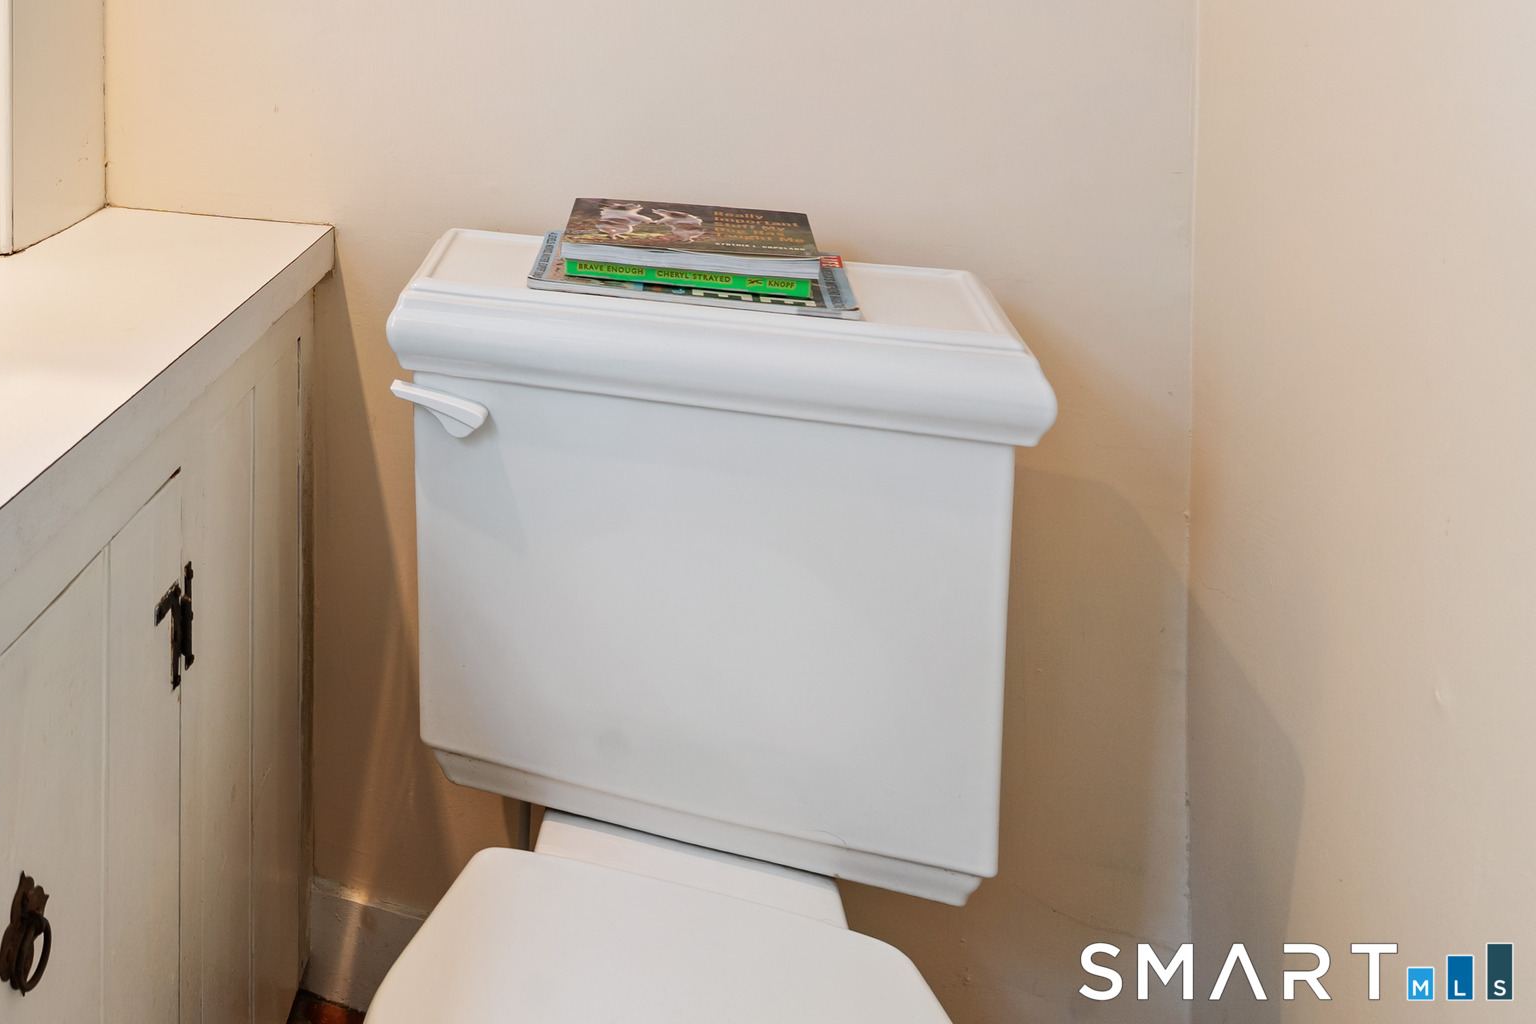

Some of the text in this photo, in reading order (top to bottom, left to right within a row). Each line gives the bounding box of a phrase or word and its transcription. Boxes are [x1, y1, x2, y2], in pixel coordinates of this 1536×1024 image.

[713, 210, 763, 220] Really
[714, 216, 799, 228] Important
[578, 263, 795, 289] BRAVE ENOUGH CHERYL STRAYED KNOPF
